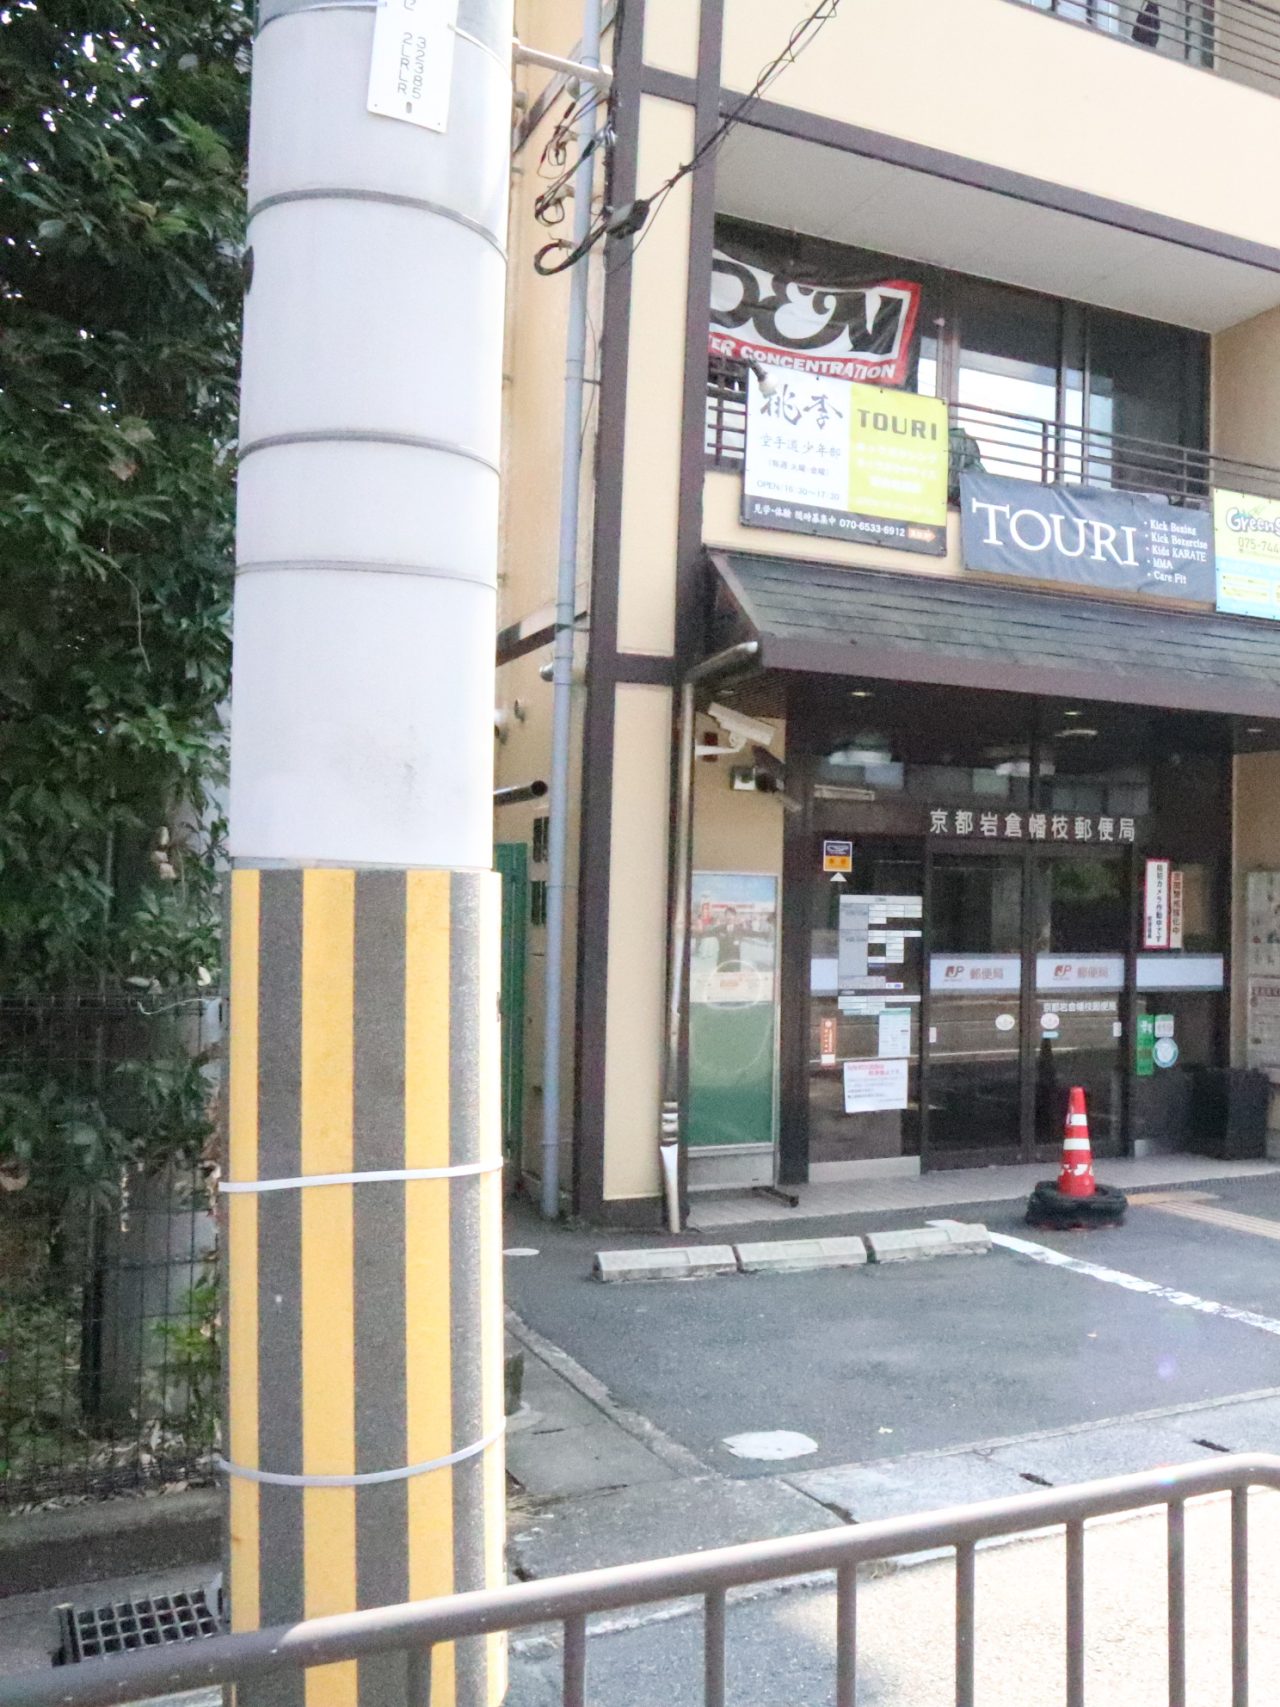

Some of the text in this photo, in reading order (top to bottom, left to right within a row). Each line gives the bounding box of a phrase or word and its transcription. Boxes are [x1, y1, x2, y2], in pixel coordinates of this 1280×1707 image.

[740, 345, 896, 379] CONCENTRATION
[857, 409, 937, 441] TOURI
[971, 497, 1139, 567] TOURI
[1150, 519, 1168, 531] Kick
[1151, 531, 1169, 544] Kick
[1152, 544, 1207, 562] Kids KARATE
[1152, 557, 1174, 570] MMA
[1153, 570, 1187, 585] Care Fit
[929, 808, 1135, 842] 京都岩倉幡枝郵便局
